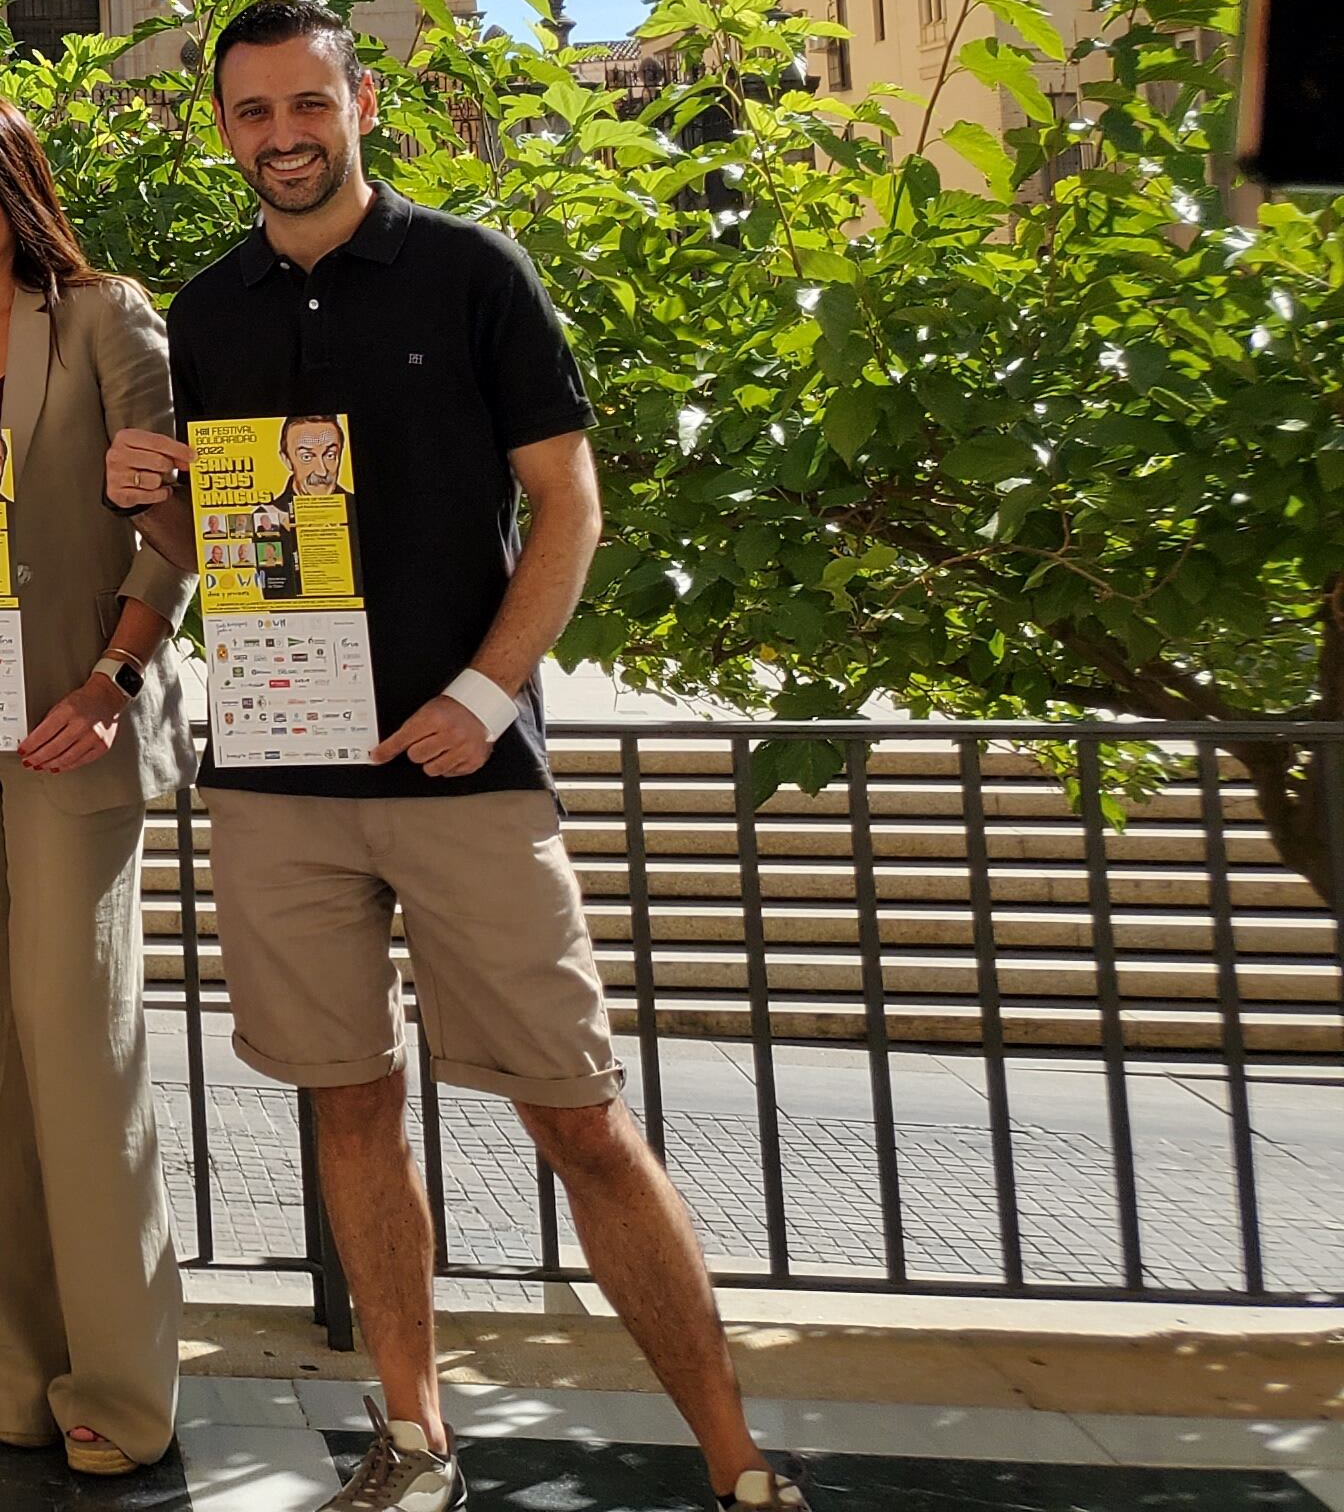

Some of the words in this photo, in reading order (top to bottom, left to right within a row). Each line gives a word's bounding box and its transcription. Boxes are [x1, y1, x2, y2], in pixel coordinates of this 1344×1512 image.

[212, 426, 255, 434] FESTIVAL
[197, 447, 224, 455] 2022
[196, 457, 253, 474] SANTI
[214, 474, 253, 489] SUS
